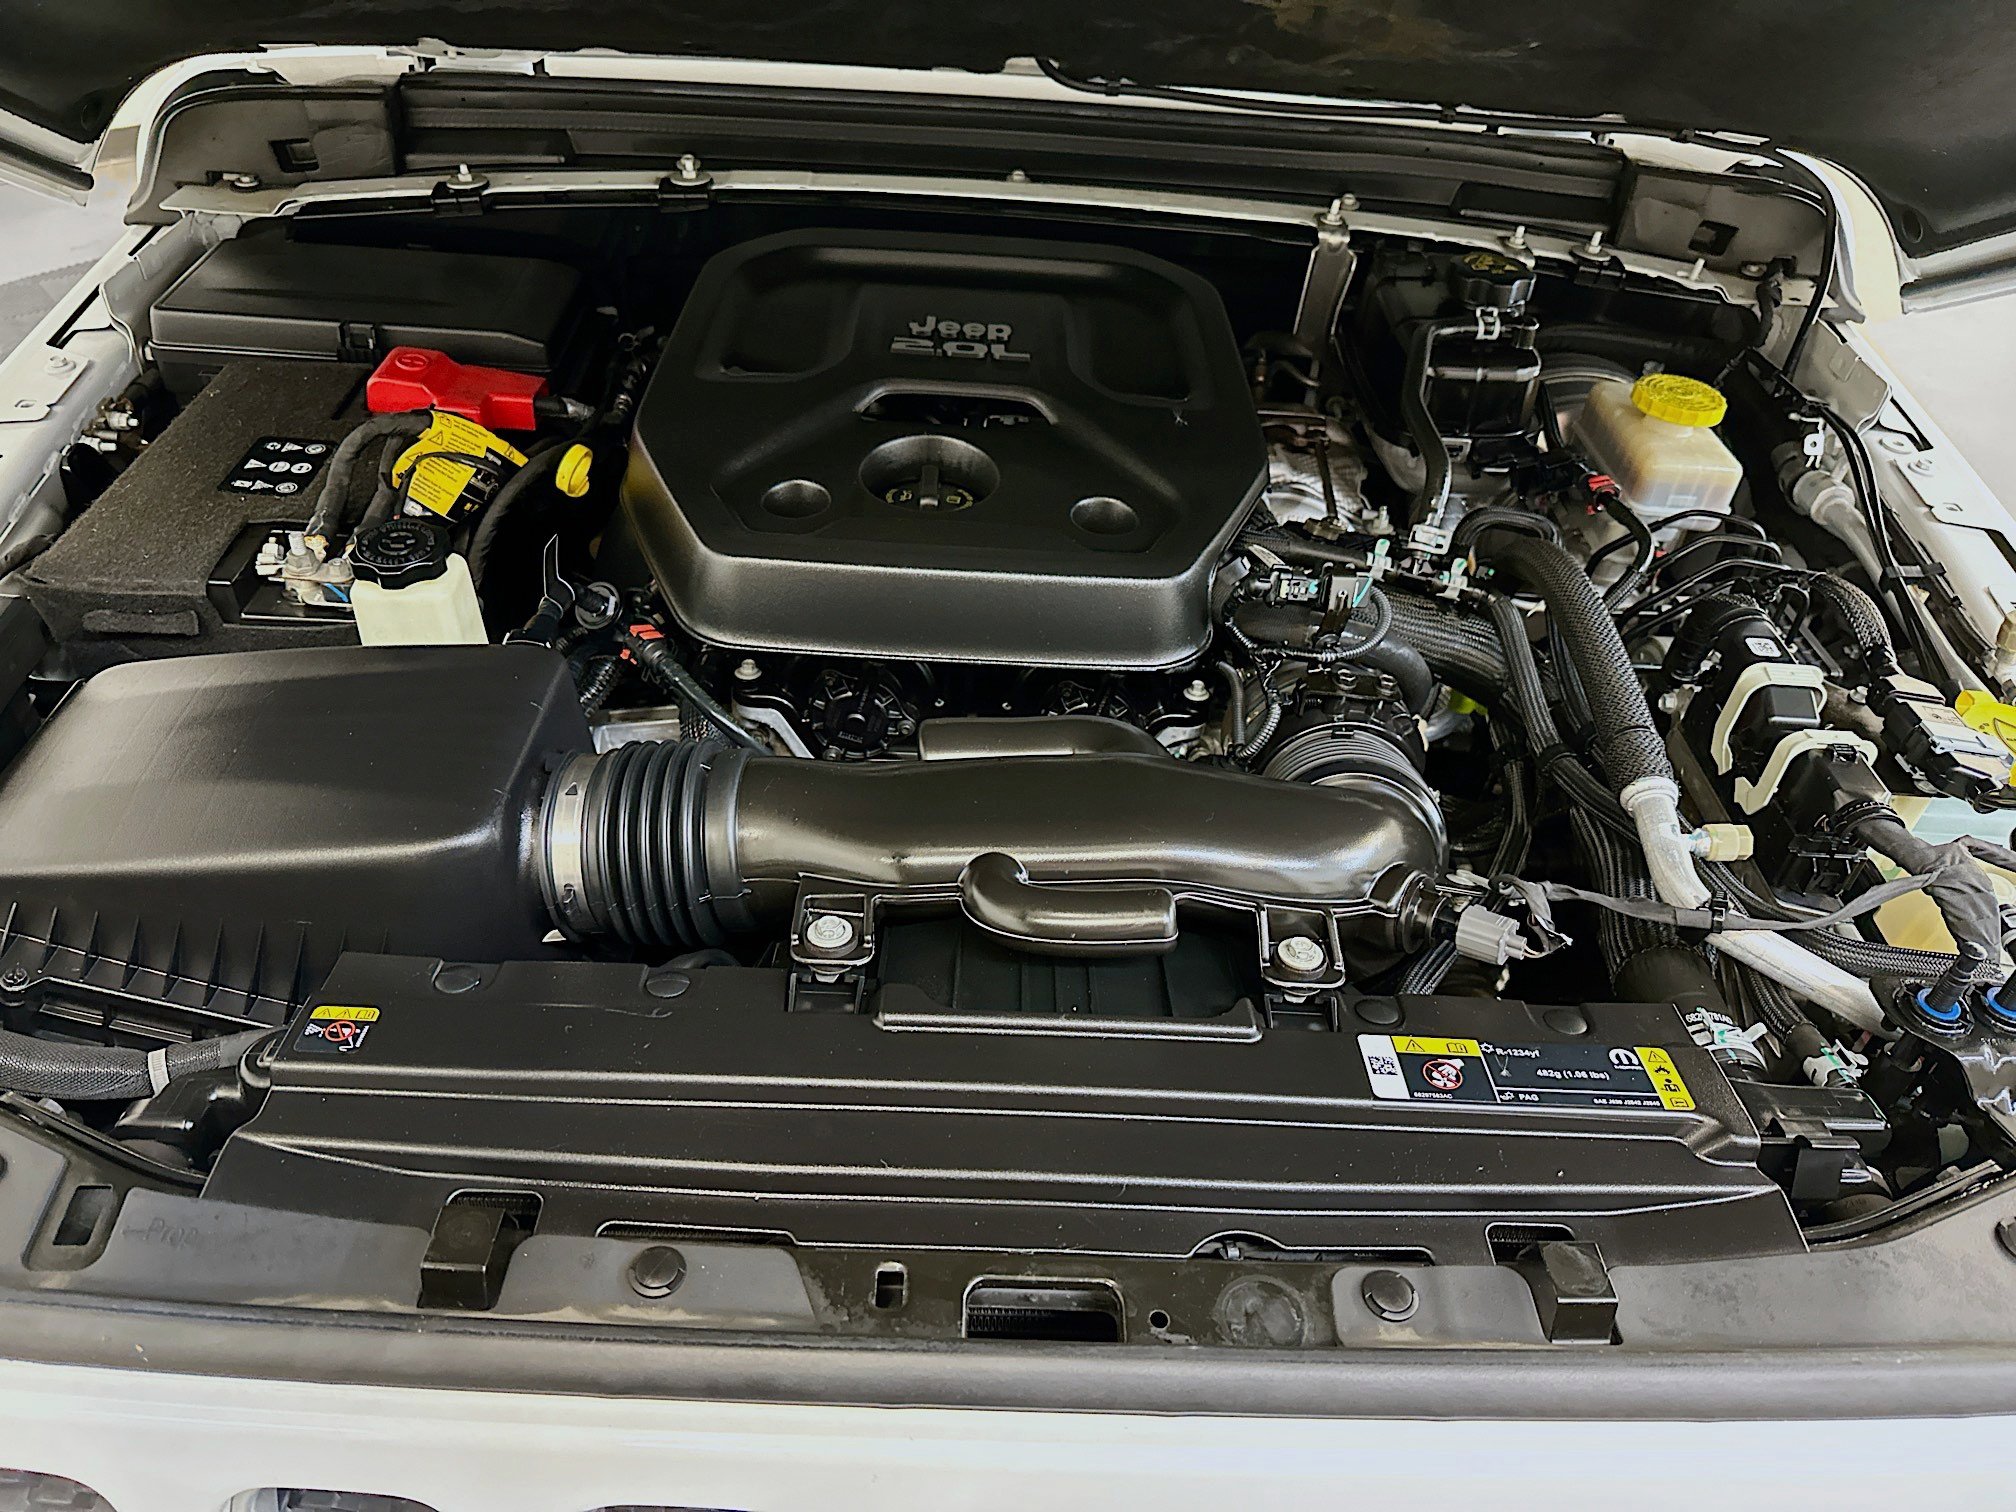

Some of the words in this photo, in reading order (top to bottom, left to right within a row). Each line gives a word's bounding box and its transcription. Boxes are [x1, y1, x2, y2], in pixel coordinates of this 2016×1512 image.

[908, 316, 1012, 341] Jeep
[890, 336, 1031, 362] 2.0L
[1495, 1048, 1540, 1059] R-1234yf
[1518, 1093, 1540, 1102] PAG
